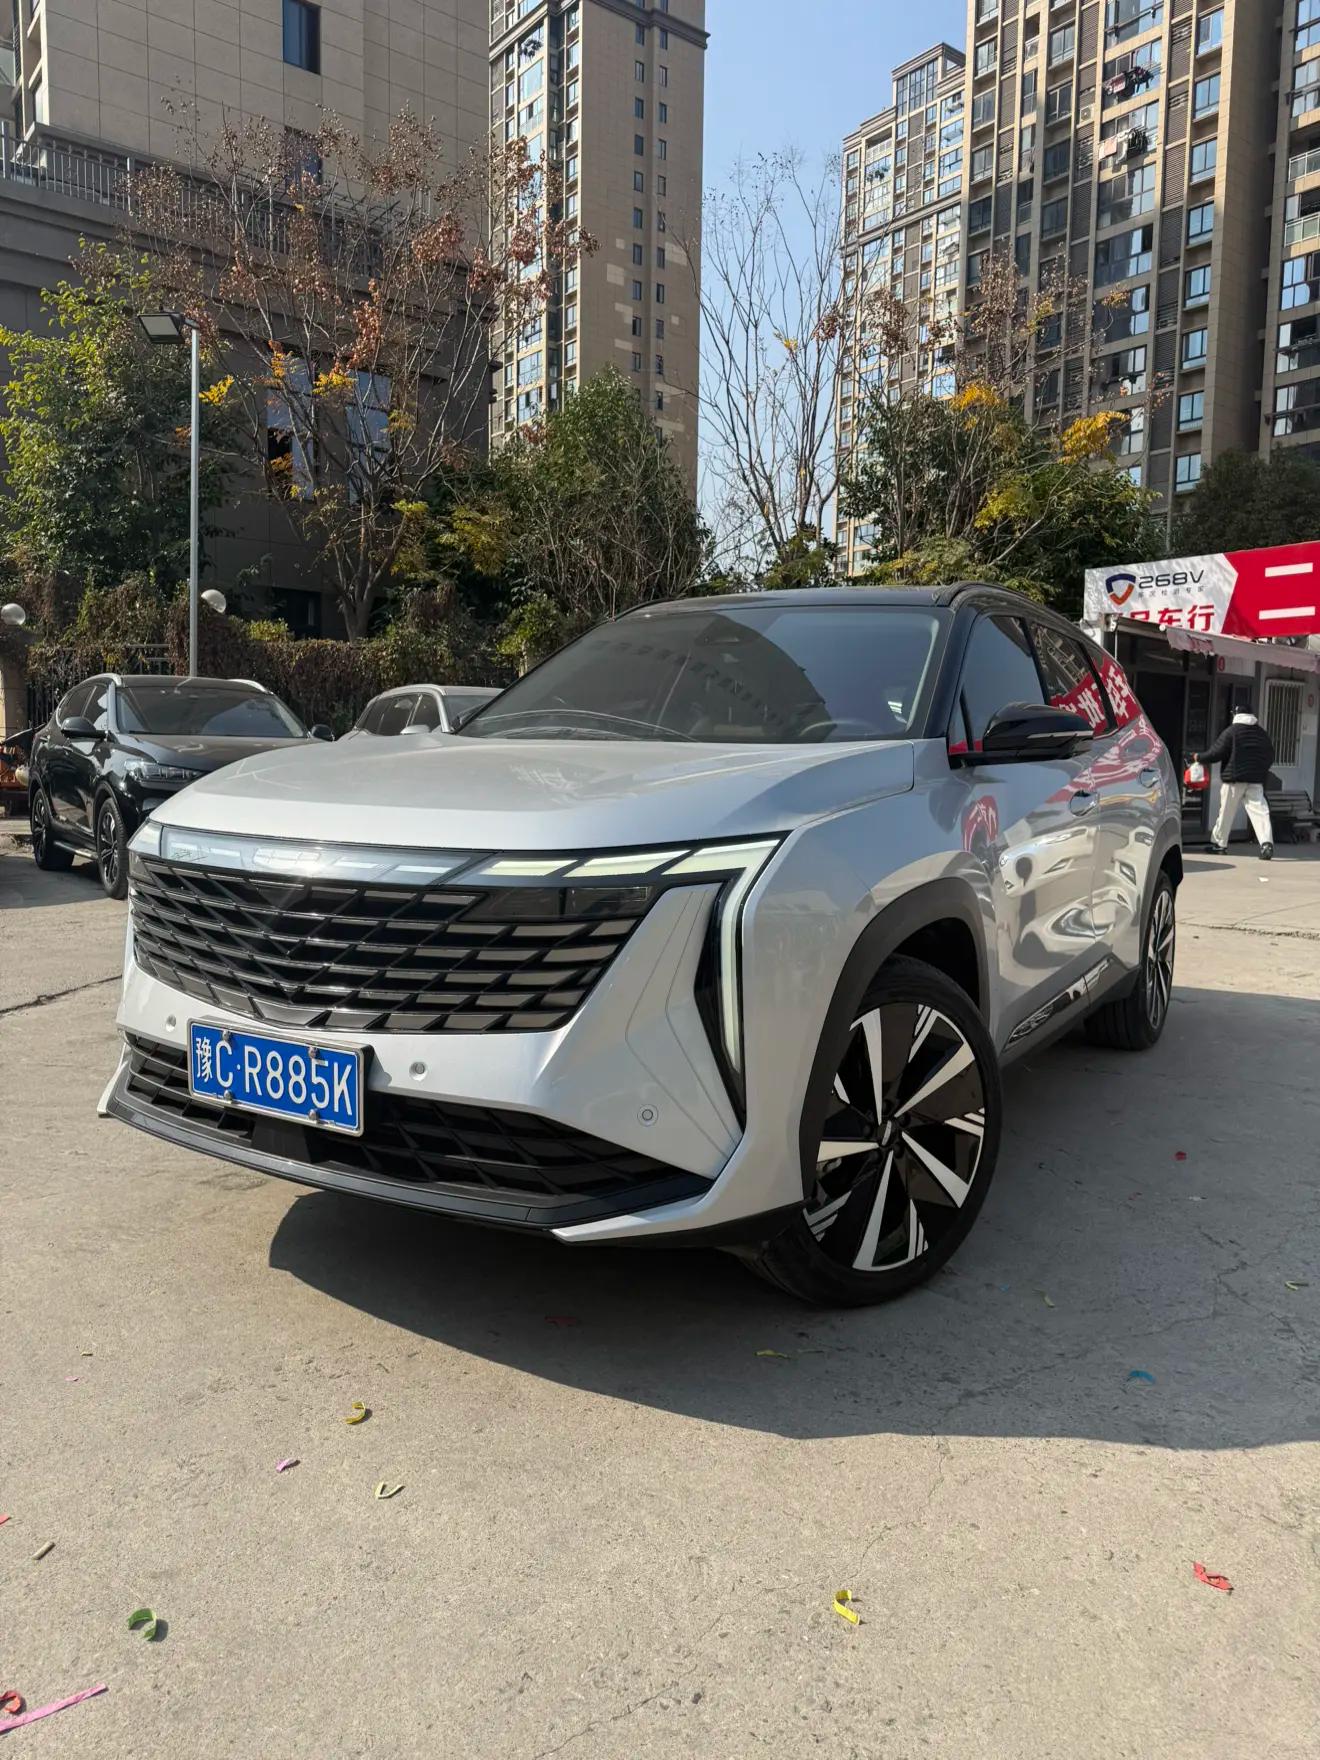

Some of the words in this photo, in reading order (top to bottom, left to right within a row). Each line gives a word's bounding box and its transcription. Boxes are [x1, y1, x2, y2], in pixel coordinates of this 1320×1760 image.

[1139, 570, 1204, 588] 268V
[1258, 562, 1316, 620] 二
[1120, 604, 1215, 632] 车行
